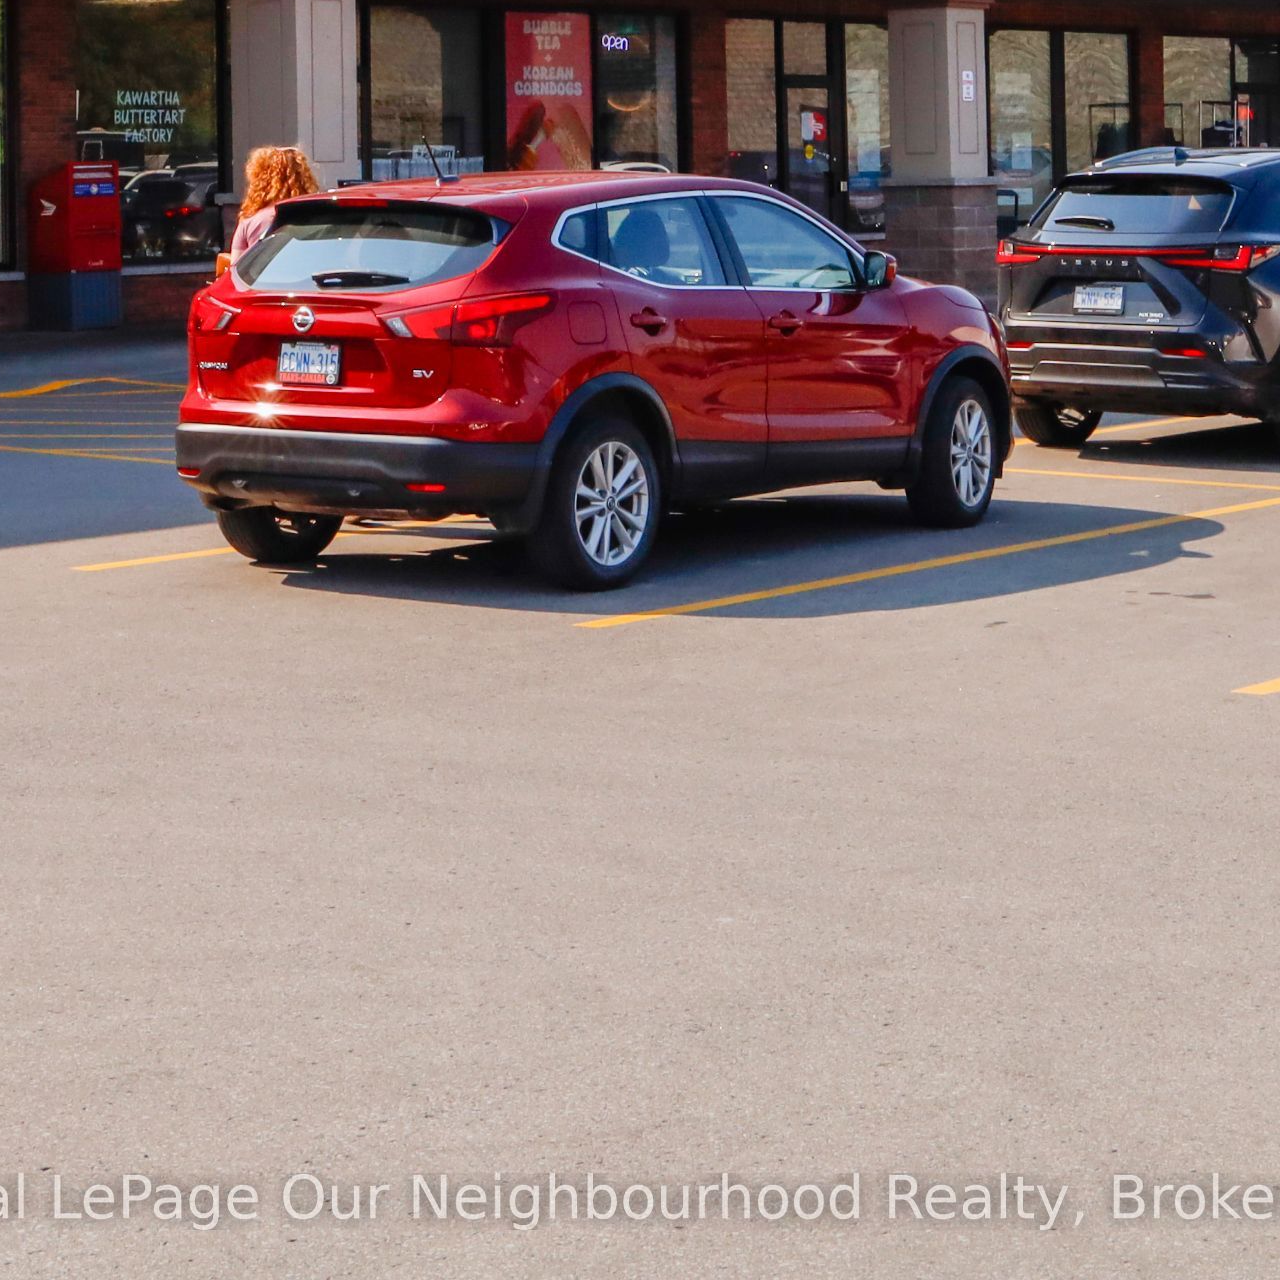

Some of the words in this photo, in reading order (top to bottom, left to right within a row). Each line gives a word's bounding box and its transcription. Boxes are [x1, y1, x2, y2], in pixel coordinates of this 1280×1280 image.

[523, 19, 572, 35] BUBBLE
[535, 35, 561, 50] TEA
[523, 66, 574, 80] KOREAN
[514, 81, 583, 97] CORNDOGS
[116, 89, 180, 106] KAWARTHA
[113, 108, 186, 125] BUTTERTART
[124, 128, 174, 143] FACTORY
[1060, 259, 1129, 267] LEXUS
[281, 351, 310, 372] CCWN
[412, 369, 434, 378] SV
